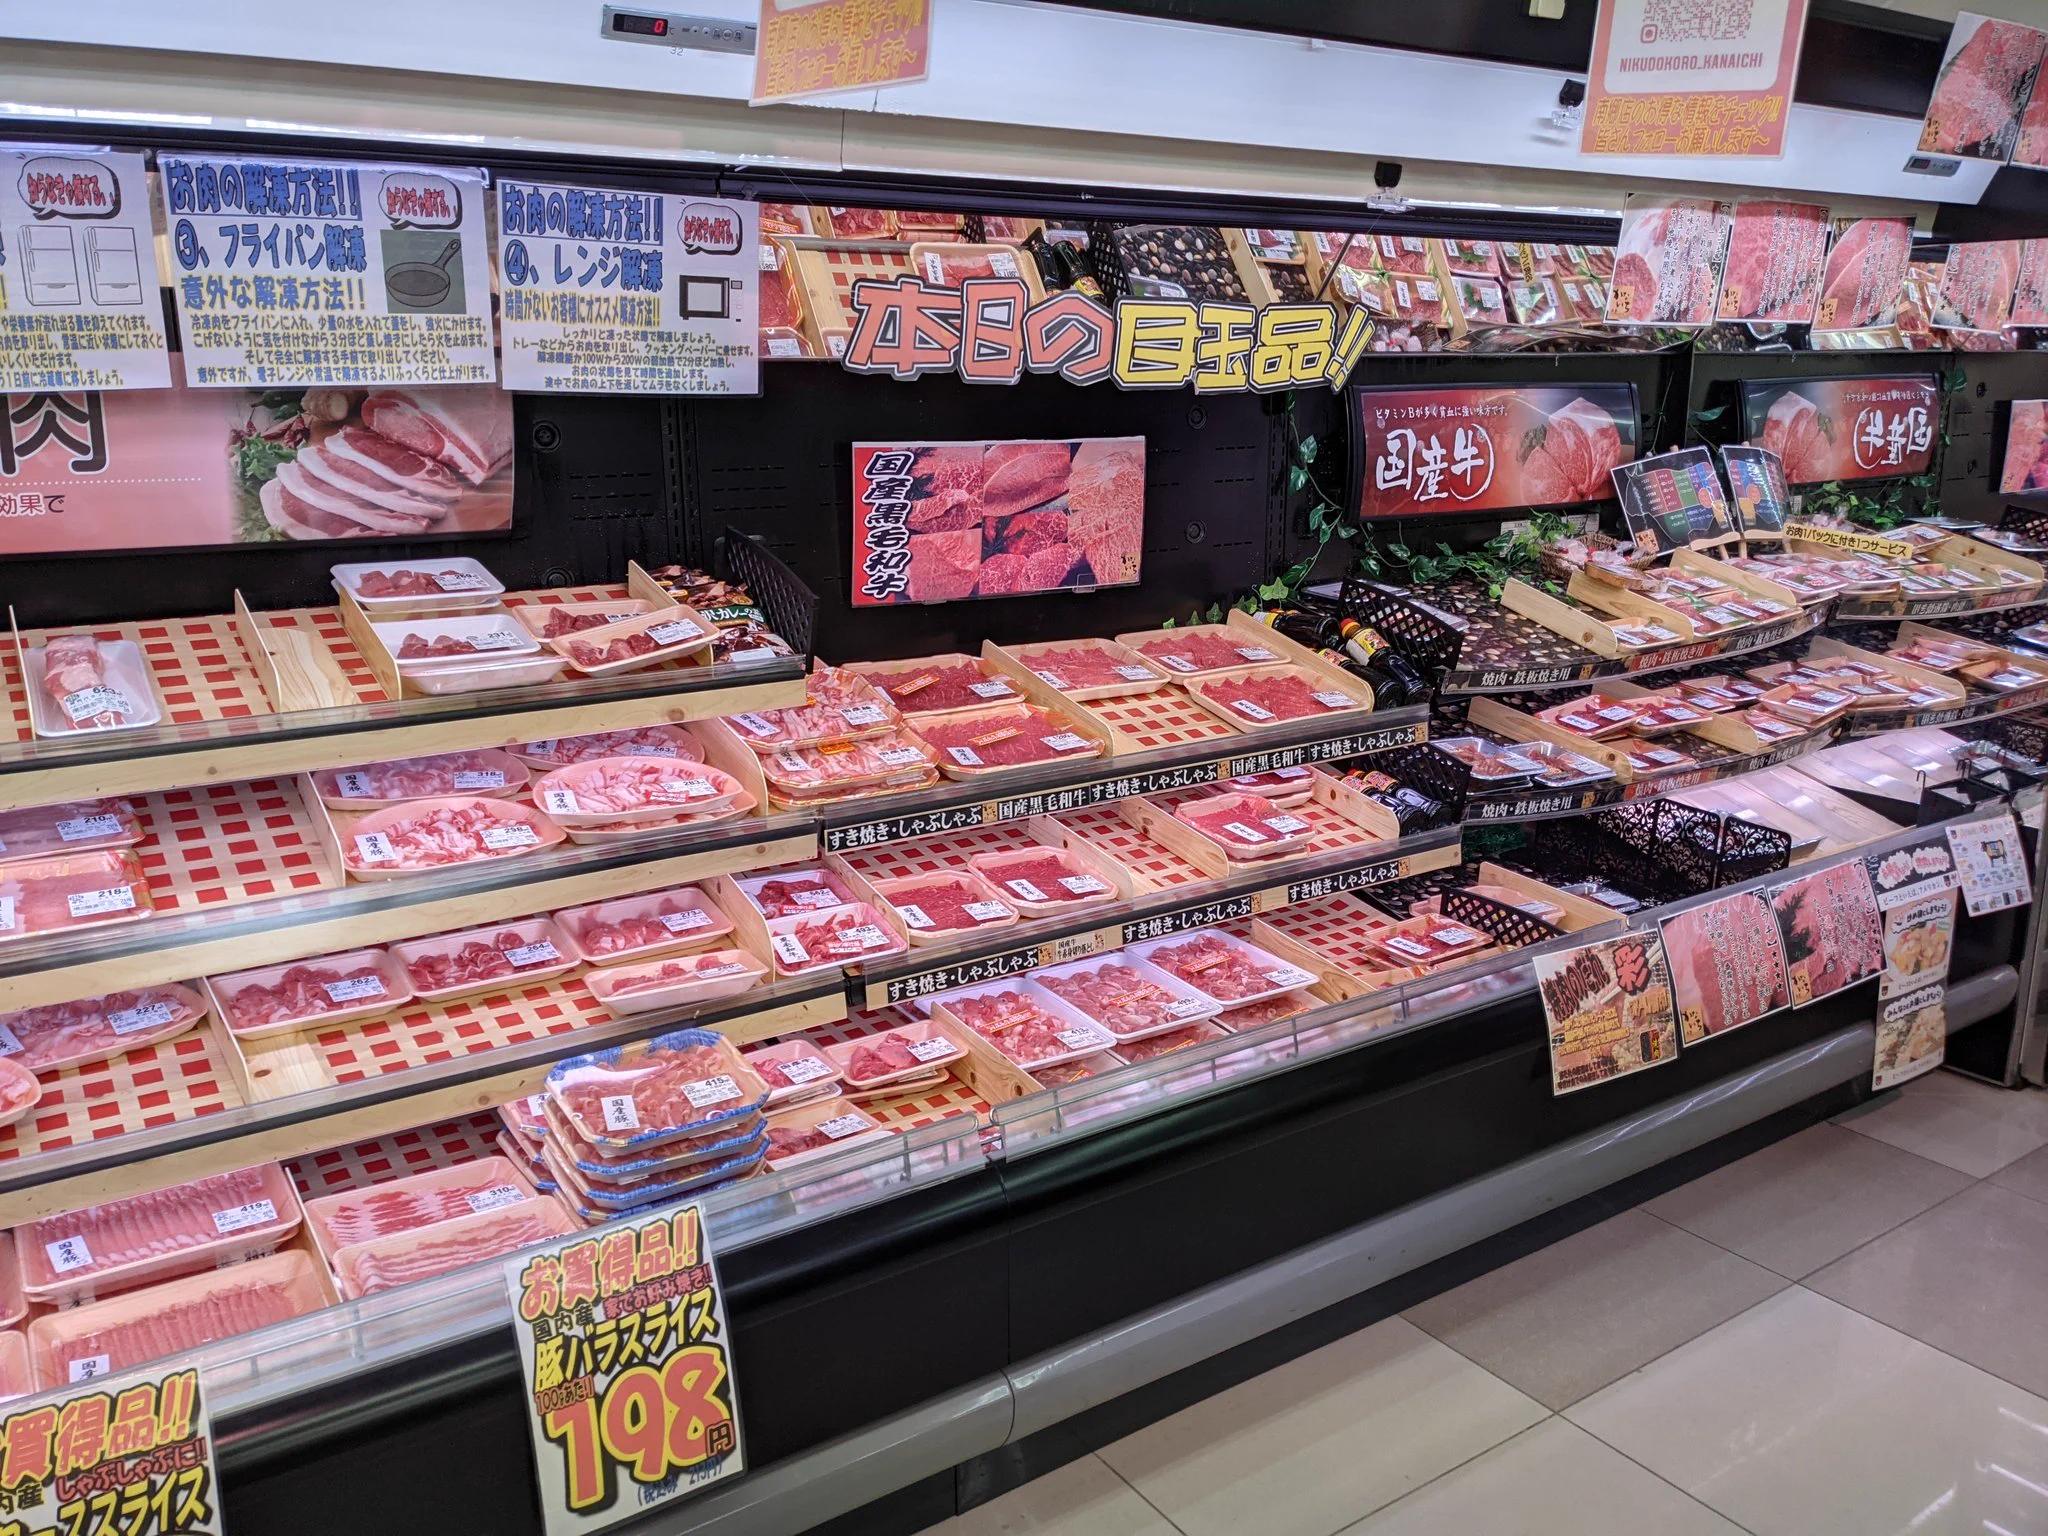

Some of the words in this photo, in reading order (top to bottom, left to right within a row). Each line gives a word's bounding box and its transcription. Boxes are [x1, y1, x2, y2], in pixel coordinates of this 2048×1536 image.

[1620, 53, 1763, 72] NIKUDOKORO_KANAICHI
[167, 163, 358, 218] お肉の解凍方法!!
[506, 184, 661, 243] お肉の解凍方法!!
[181, 274, 366, 310] 意外な解凍方法!!
[846, 278, 1374, 394] 本日の目玉品!!
[1375, 424, 1488, 503] 国産牛
[862, 452, 915, 598] 国産黒毛和牛
[1786, 525, 1908, 558] お肉1パックに付き1つサービス
[1481, 668, 1570, 687] 焼肉・鉄板焼き用
[1232, 748, 1306, 776] 国産黒毛和牛
[1310, 727, 1415, 760] すき焼き・しゃぶしゃぶ
[999, 790, 1087, 819] 国産黒毛和牛
[1092, 765, 1217, 801] すき焼き・しゃぶしゃぶ
[829, 808, 982, 848] すき焼き・しゃぶしゃぶ
[1481, 796, 1571, 818] 焼肉・鉄板焼き用
[1289, 861, 1399, 902] すき焼き・しゃぶしゃぶ
[1124, 897, 1252, 942] すき焼き・しゃぶしゃぶ
[889, 949, 1039, 1001] すき焼き・しゃぶしゃぶ
[518, 1207, 703, 1321] お買得品!!
[602, 1263, 713, 1319] 家でお好み焼き!!
[533, 1305, 595, 1340] 国内産
[534, 1288, 717, 1392] 豚バラスライス
[0, 1369, 198, 1492] 買得品!!
[546, 1346, 730, 1509] 198
[707, 1420, 735, 1457] 円
[57, 1437, 208, 1503] しゃぶしゃぶに!!
